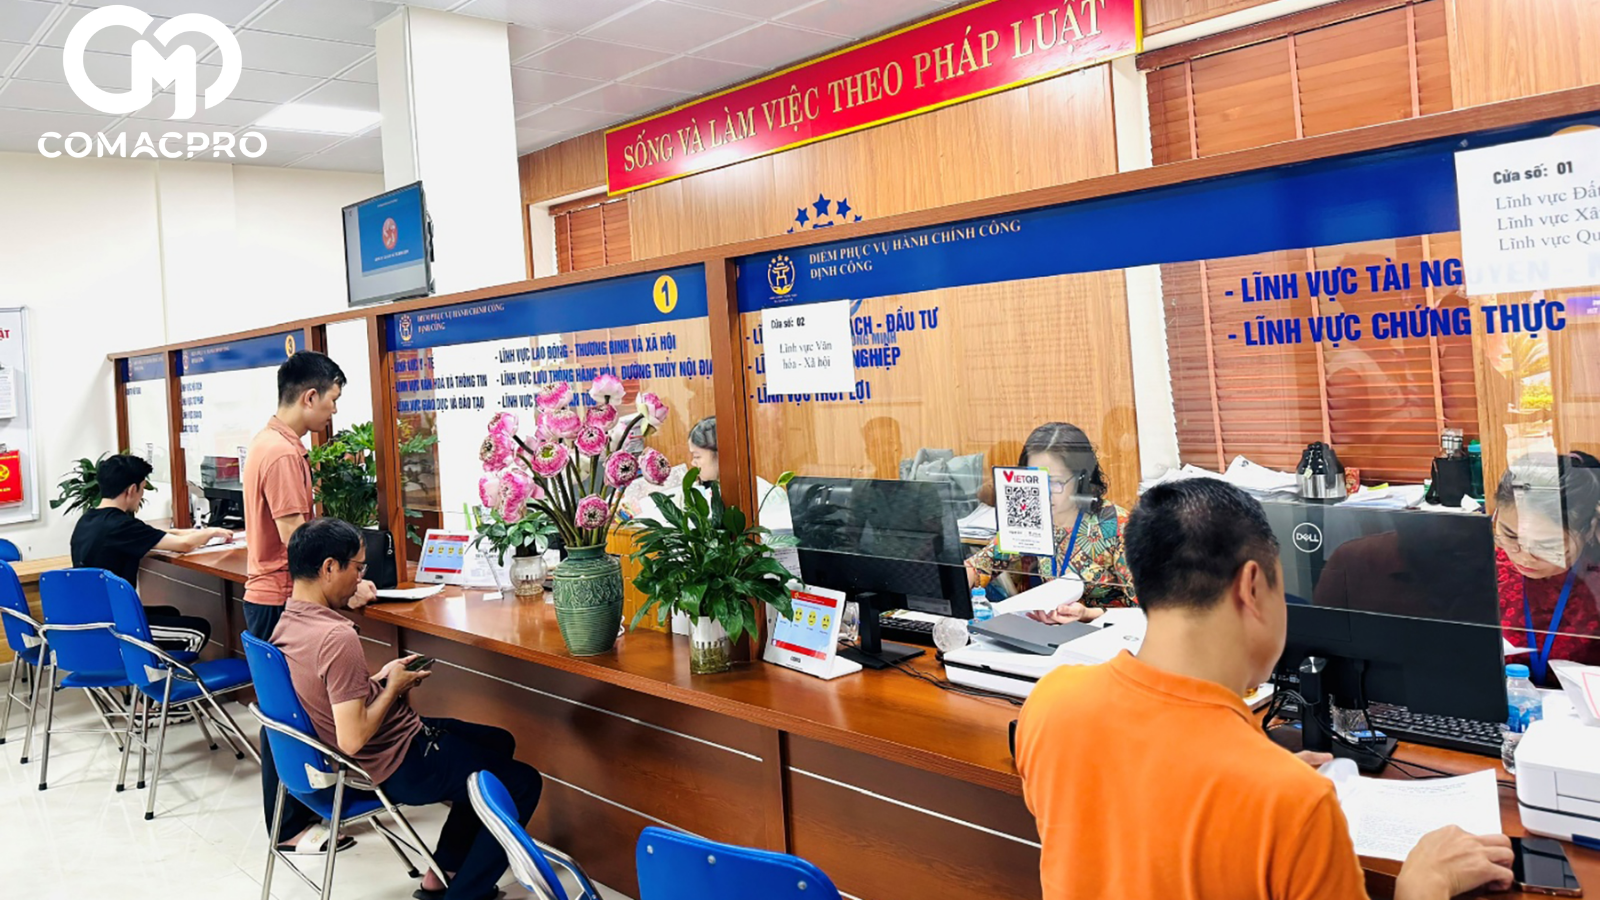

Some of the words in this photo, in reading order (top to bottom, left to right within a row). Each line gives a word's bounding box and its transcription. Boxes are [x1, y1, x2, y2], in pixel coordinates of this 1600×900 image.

[624, 129, 674, 172] SỐNG
[677, 118, 705, 156] VÀ
[709, 106, 756, 149] LÀM
[761, 85, 819, 132] VIỆC
[828, 61, 903, 113] THEO
[913, 25, 1000, 89] PHÁP
[1010, 0, 1105, 59] LUẬT
[1493, 169, 1520, 184] Cửa
[1557, 161, 1573, 175] 01
[1496, 194, 1532, 210] Lĩnh
[1537, 192, 1567, 206] vực
[1498, 215, 1534, 231] Lĩnh
[1539, 213, 1569, 227] vực
[840, 244, 871, 260] PHỤC
[873, 241, 890, 255] VỤ
[893, 234, 929, 251] HÀNH
[931, 226, 975, 245] CHÍNH
[979, 219, 1021, 238] CÔNG
[1499, 236, 1535, 251] Lĩnh
[1541, 234, 1571, 248] vực
[839, 259, 873, 275] CÔNG
[1241, 271, 1298, 303] LĨNH
[1305, 266, 1358, 302] VỰC
[1365, 257, 1411, 292] TÀI
[661, 280, 670, 307] 1
[796, 316, 805, 327] 02
[885, 305, 915, 333] ĐẦU
[919, 306, 939, 330] TƯ
[1244, 315, 1301, 346] LĨNH
[1308, 312, 1361, 348] VỰC
[1371, 304, 1472, 339] CHỨNG
[1481, 299, 1566, 338] THỰC
[499, 347, 515, 363] LĨNH
[516, 347, 530, 365] VỰC
[531, 346, 546, 361] LAO
[547, 342, 568, 362] ĐỘNG
[575, 341, 607, 357] THƯƠNG
[609, 339, 630, 355] BINH
[631, 334, 643, 353] VÀ
[645, 332, 658, 352] XÃ
[660, 331, 676, 354] HỘI
[815, 341, 832, 351] Văn
[455, 372, 475, 388] THÔNG
[477, 374, 488, 387] TIN
[500, 370, 516, 386] LĨNH
[518, 371, 532, 388] VỰC
[621, 361, 652, 380] ĐƯỜNG
[653, 356, 676, 378] THỦY
[680, 357, 697, 380] NỘI
[472, 396, 484, 412] TẠO
[502, 393, 518, 408] LĨNH
[1003, 470, 1039, 484] VIETQR
[1296, 533, 1319, 543] DELL
